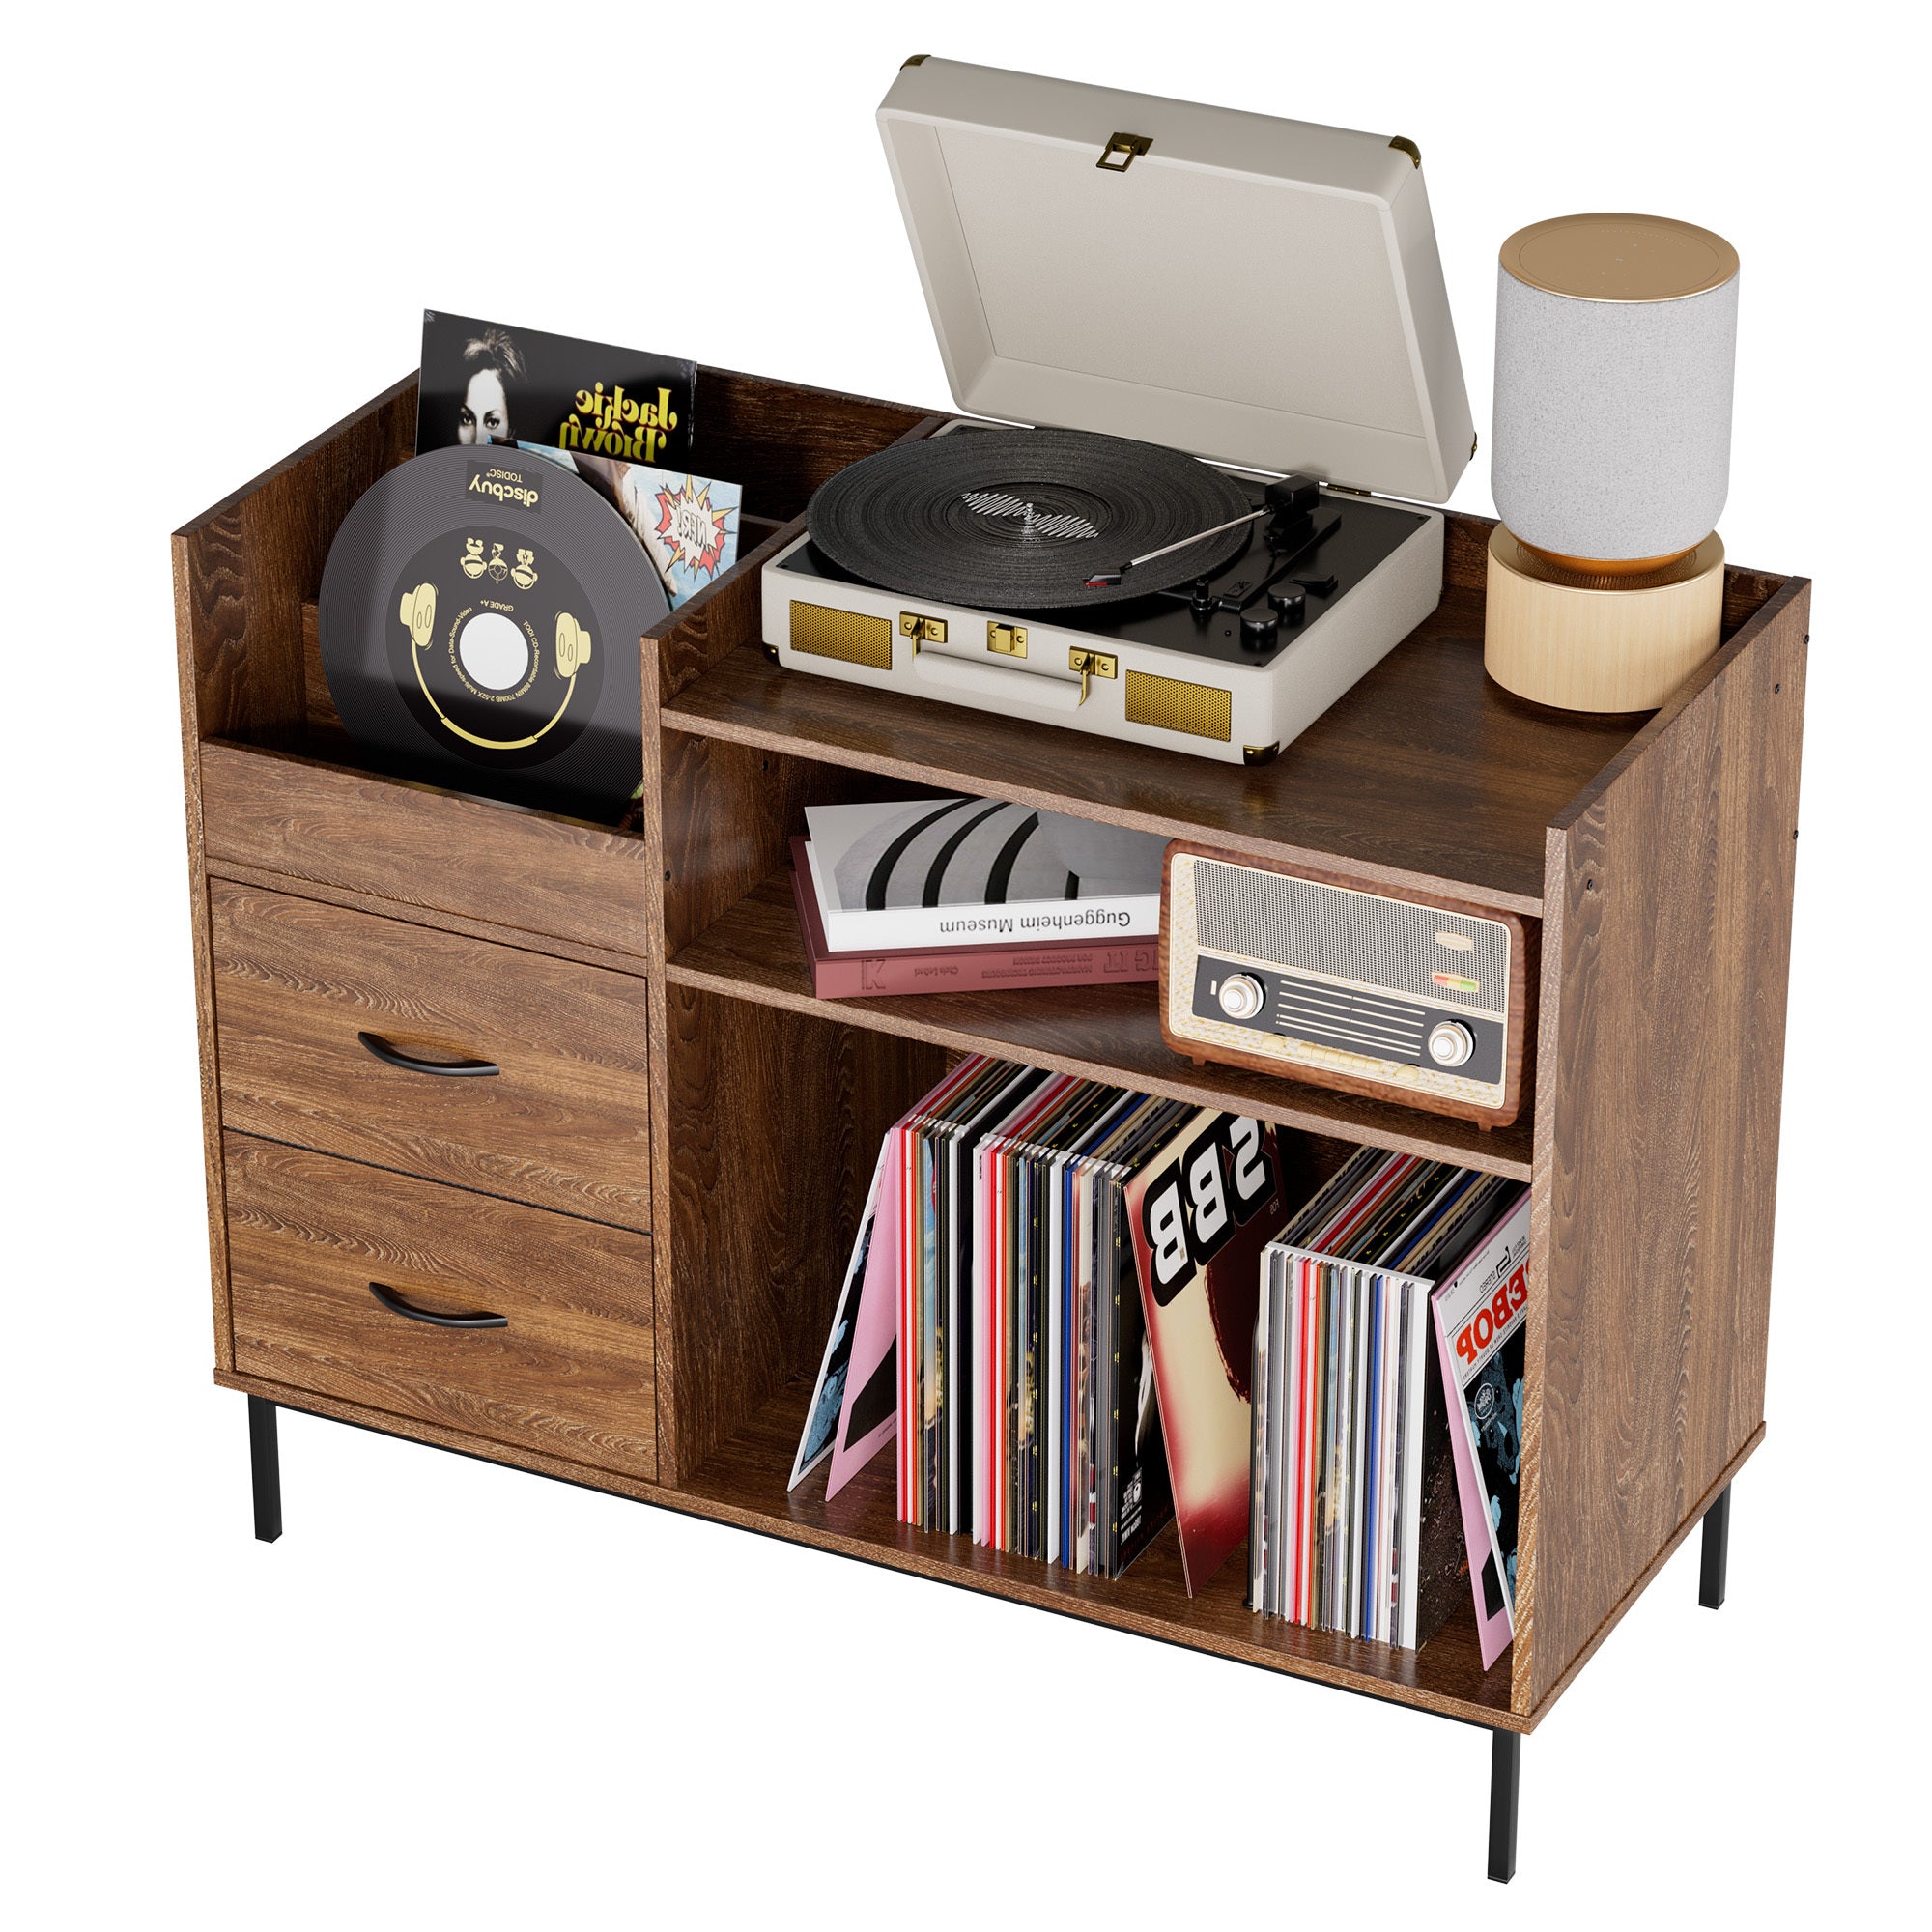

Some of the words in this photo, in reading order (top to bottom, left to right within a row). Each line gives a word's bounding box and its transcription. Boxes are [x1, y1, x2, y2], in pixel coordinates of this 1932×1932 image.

[469, 474, 539, 508] discbuy
[490, 600, 514, 612] GRADE
[523, 619, 535, 638] TODI
[940, 918, 1013, 933] Museum
[1020, 909, 1131, 931] Guggenheim
